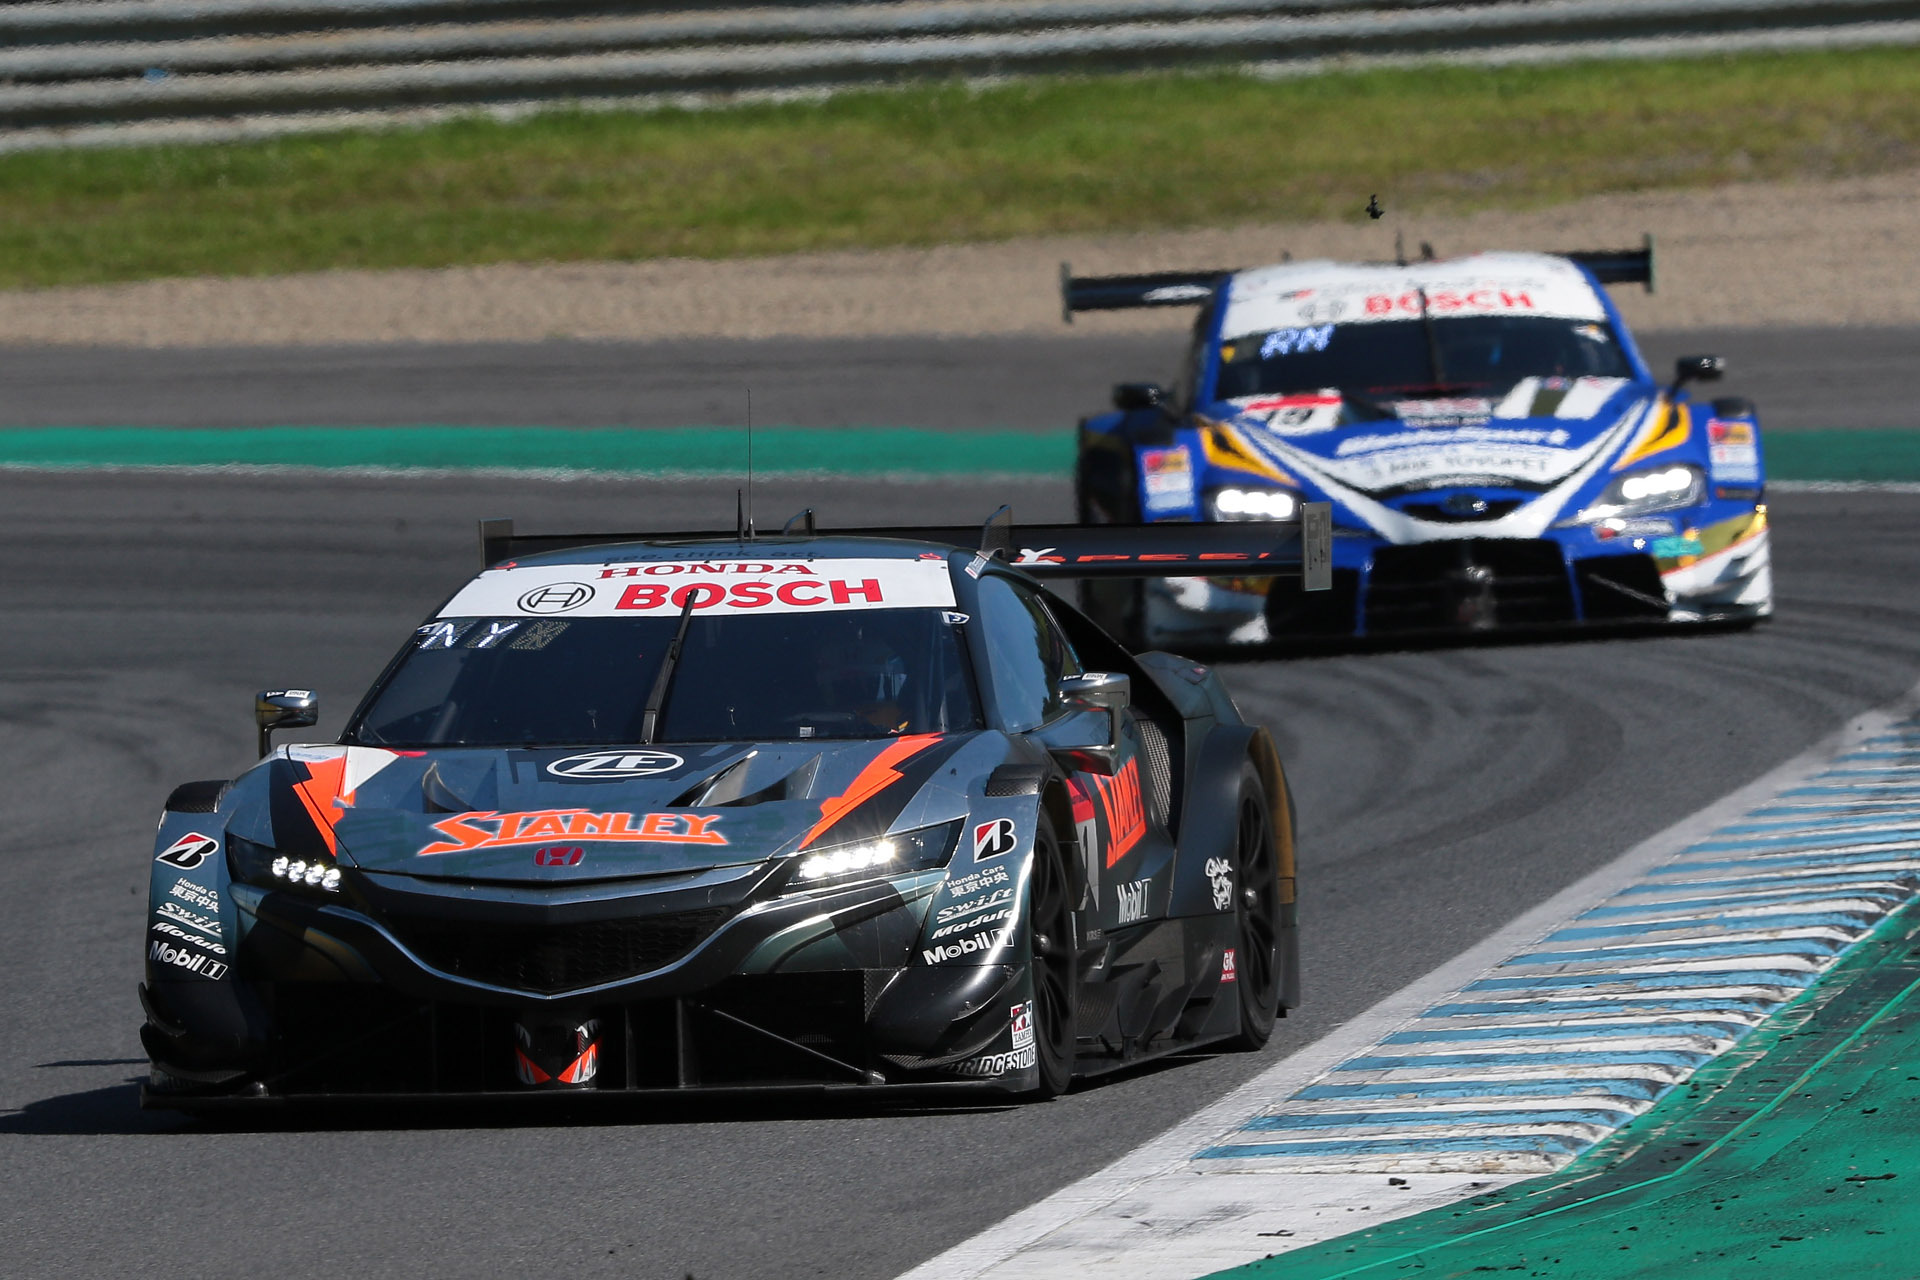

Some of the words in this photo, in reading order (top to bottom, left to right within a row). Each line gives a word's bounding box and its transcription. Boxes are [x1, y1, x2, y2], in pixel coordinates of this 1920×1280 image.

[1363, 288, 1534, 316] BOSCH
[596, 563, 818, 579] HONDA
[614, 578, 884, 610] BOSCH
[566, 755, 658, 773] ZF
[417, 808, 729, 856] STANLEY
[178, 877, 206, 896] Honda
[947, 873, 981, 889] Honda
[982, 864, 1005, 878] Cars
[950, 871, 1010, 898] 東京中央
[169, 884, 220, 914] 東京中央
[1117, 880, 1142, 924] Mobil
[152, 922, 227, 955] Modulo
[931, 908, 1016, 940] Modulo
[150, 940, 206, 972] Mobil
[923, 930, 991, 965] Mobil
